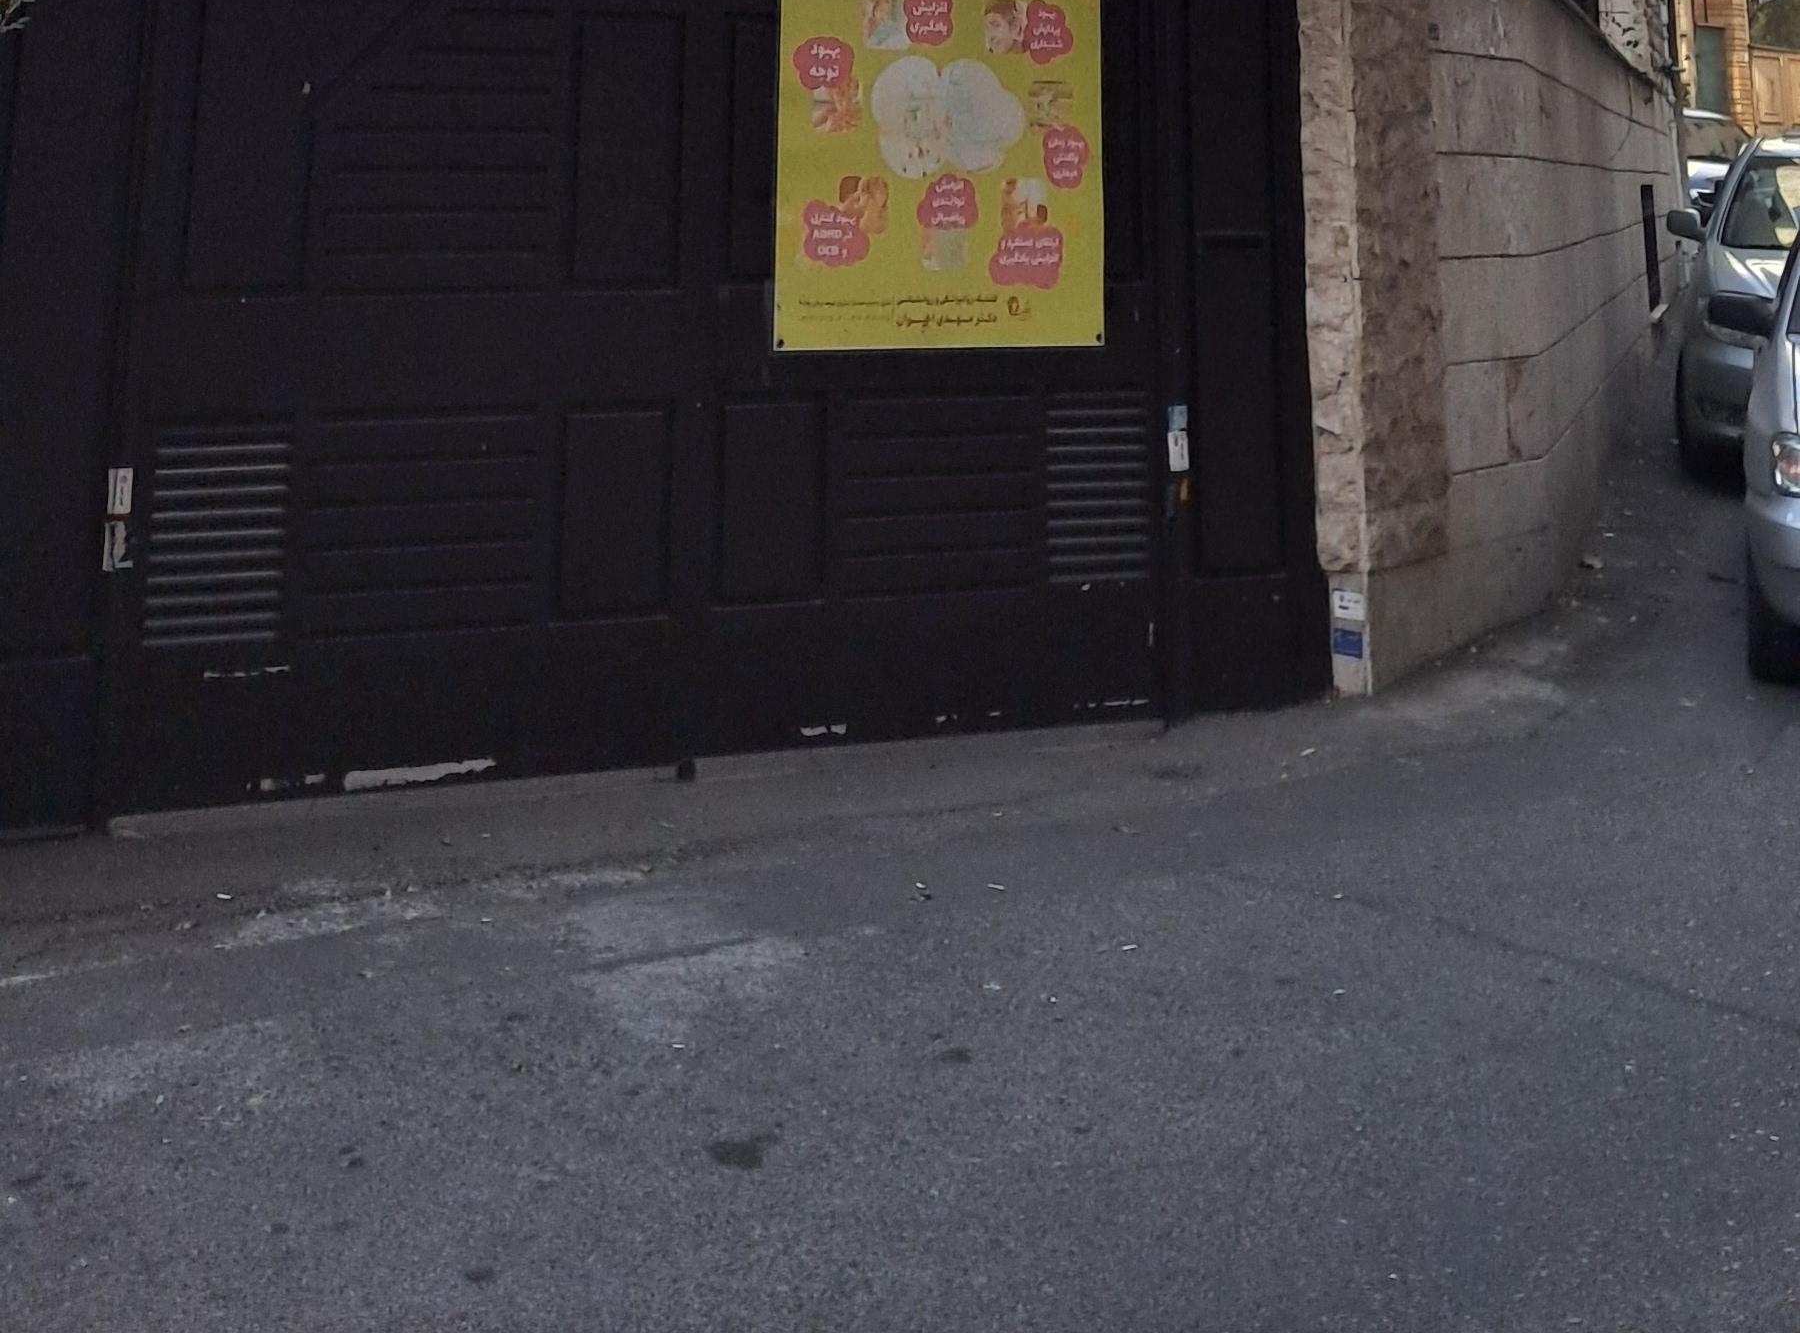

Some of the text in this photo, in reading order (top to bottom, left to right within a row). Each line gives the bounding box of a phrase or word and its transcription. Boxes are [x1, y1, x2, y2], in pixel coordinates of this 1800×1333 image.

[912, 1, 948, 16] افزایش
[810, 43, 841, 59] بهبود
[809, 65, 839, 82] توجه
